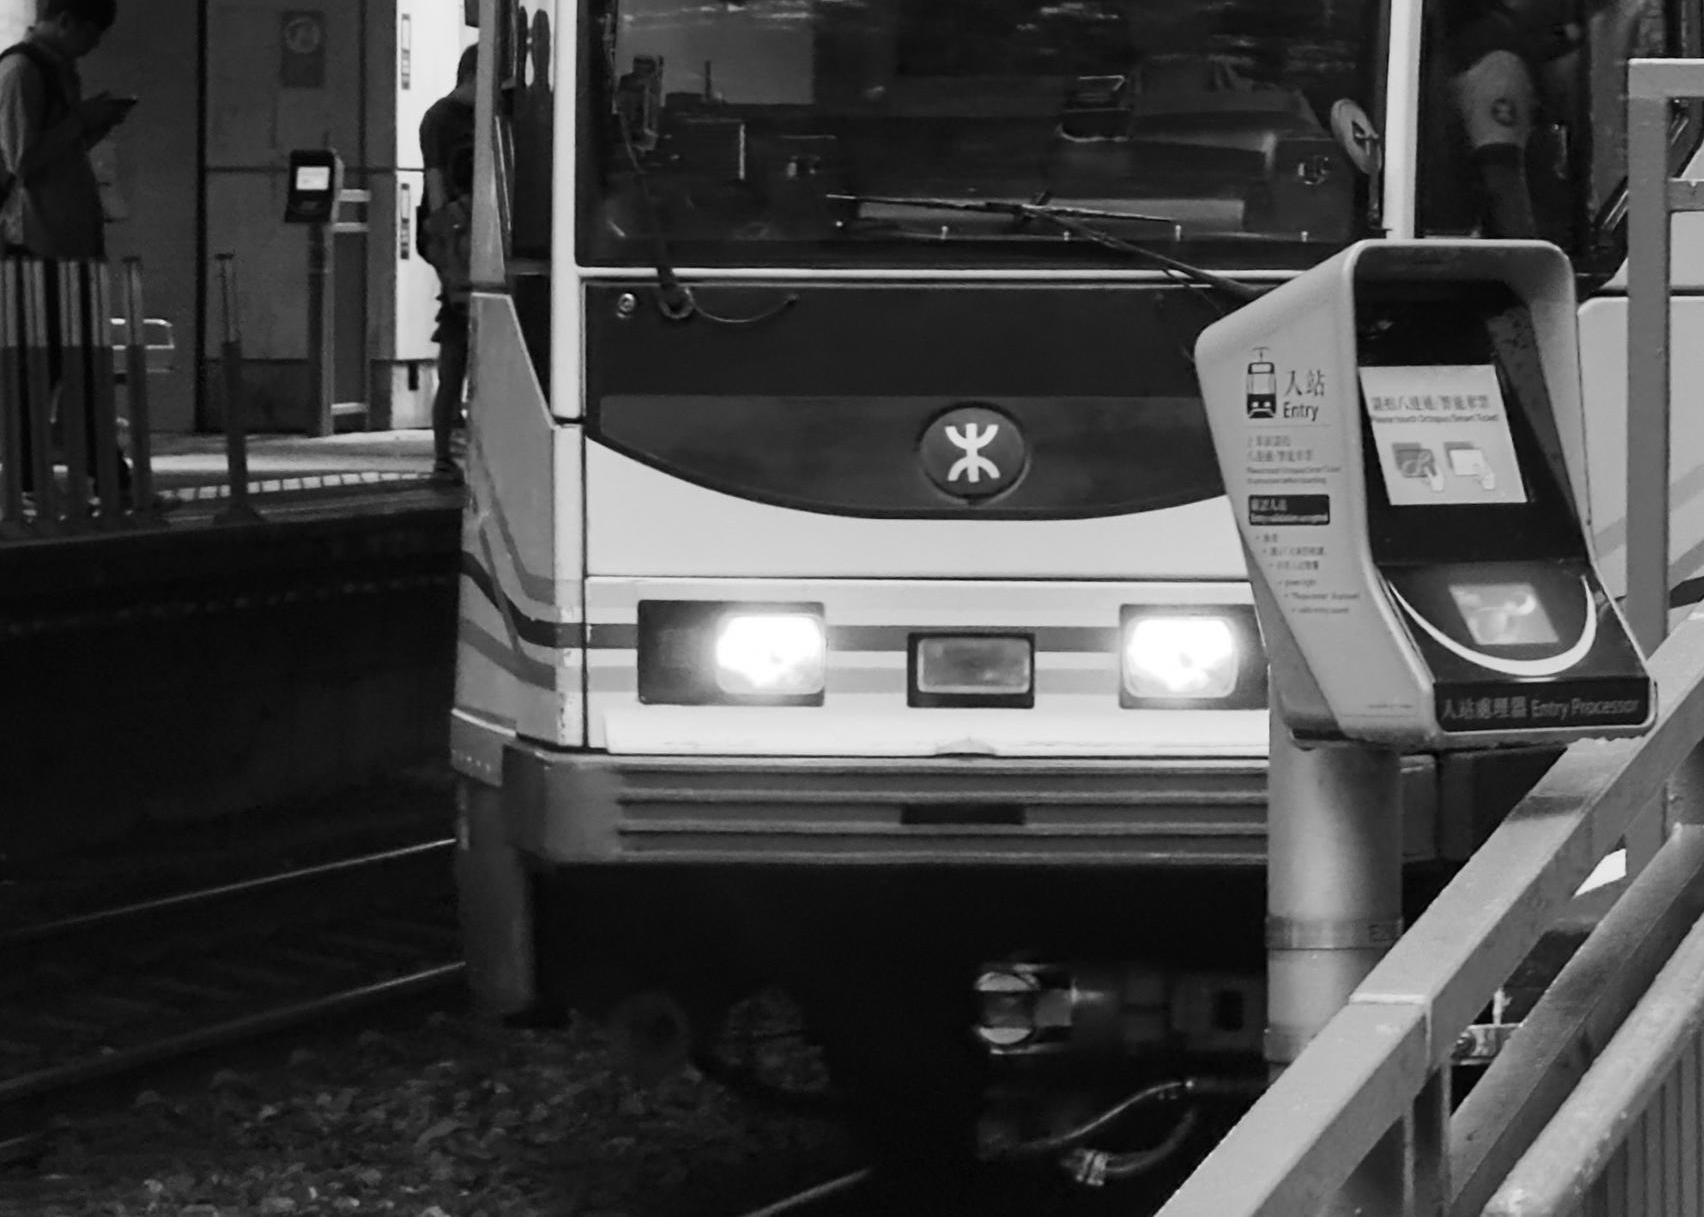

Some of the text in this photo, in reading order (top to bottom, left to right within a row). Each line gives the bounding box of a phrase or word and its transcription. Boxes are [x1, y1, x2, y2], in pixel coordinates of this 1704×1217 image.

[1284, 369, 1326, 397] 入站
[1283, 401, 1319, 422] Entry
[1531, 699, 1570, 720] Entry
[1571, 697, 1640, 716] Processor
